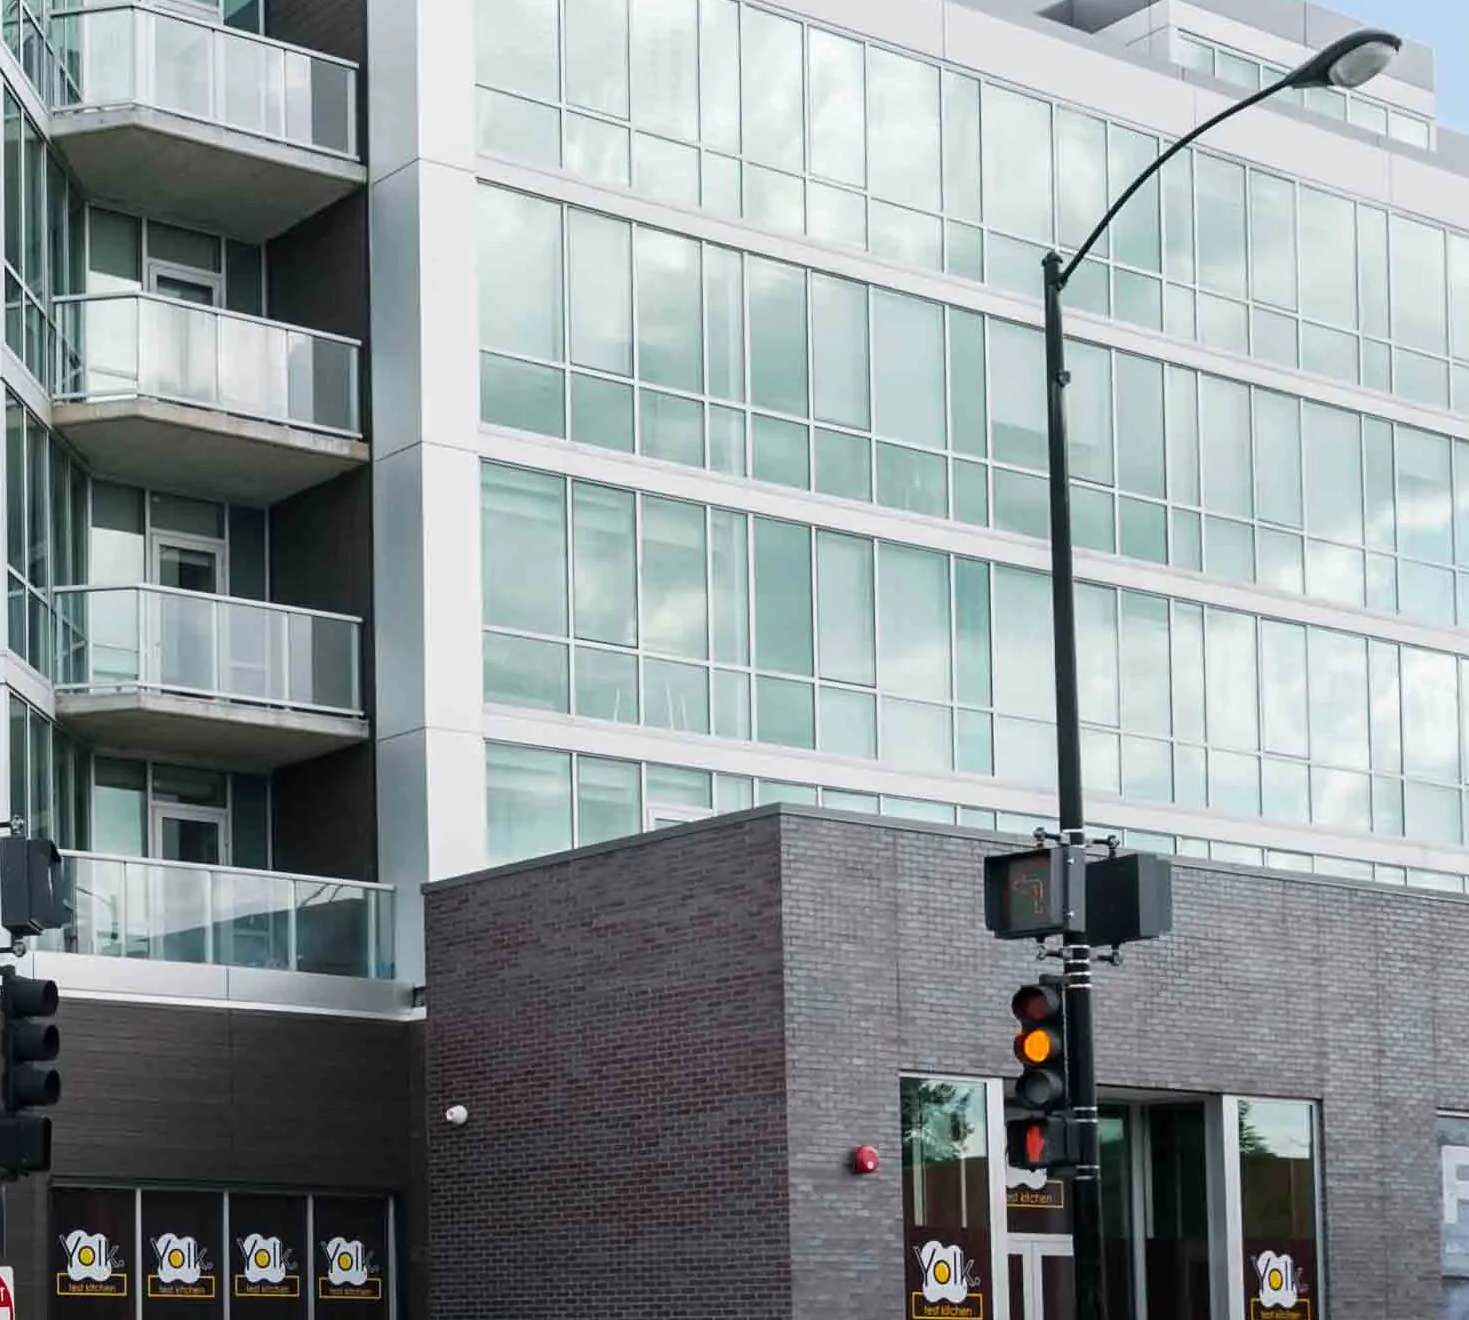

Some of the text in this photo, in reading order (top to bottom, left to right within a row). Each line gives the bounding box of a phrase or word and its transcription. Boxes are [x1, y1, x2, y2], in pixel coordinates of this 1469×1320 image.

[1007, 1192, 1052, 1203] est kitchen
[924, 1305, 972, 1316] test kitchen
